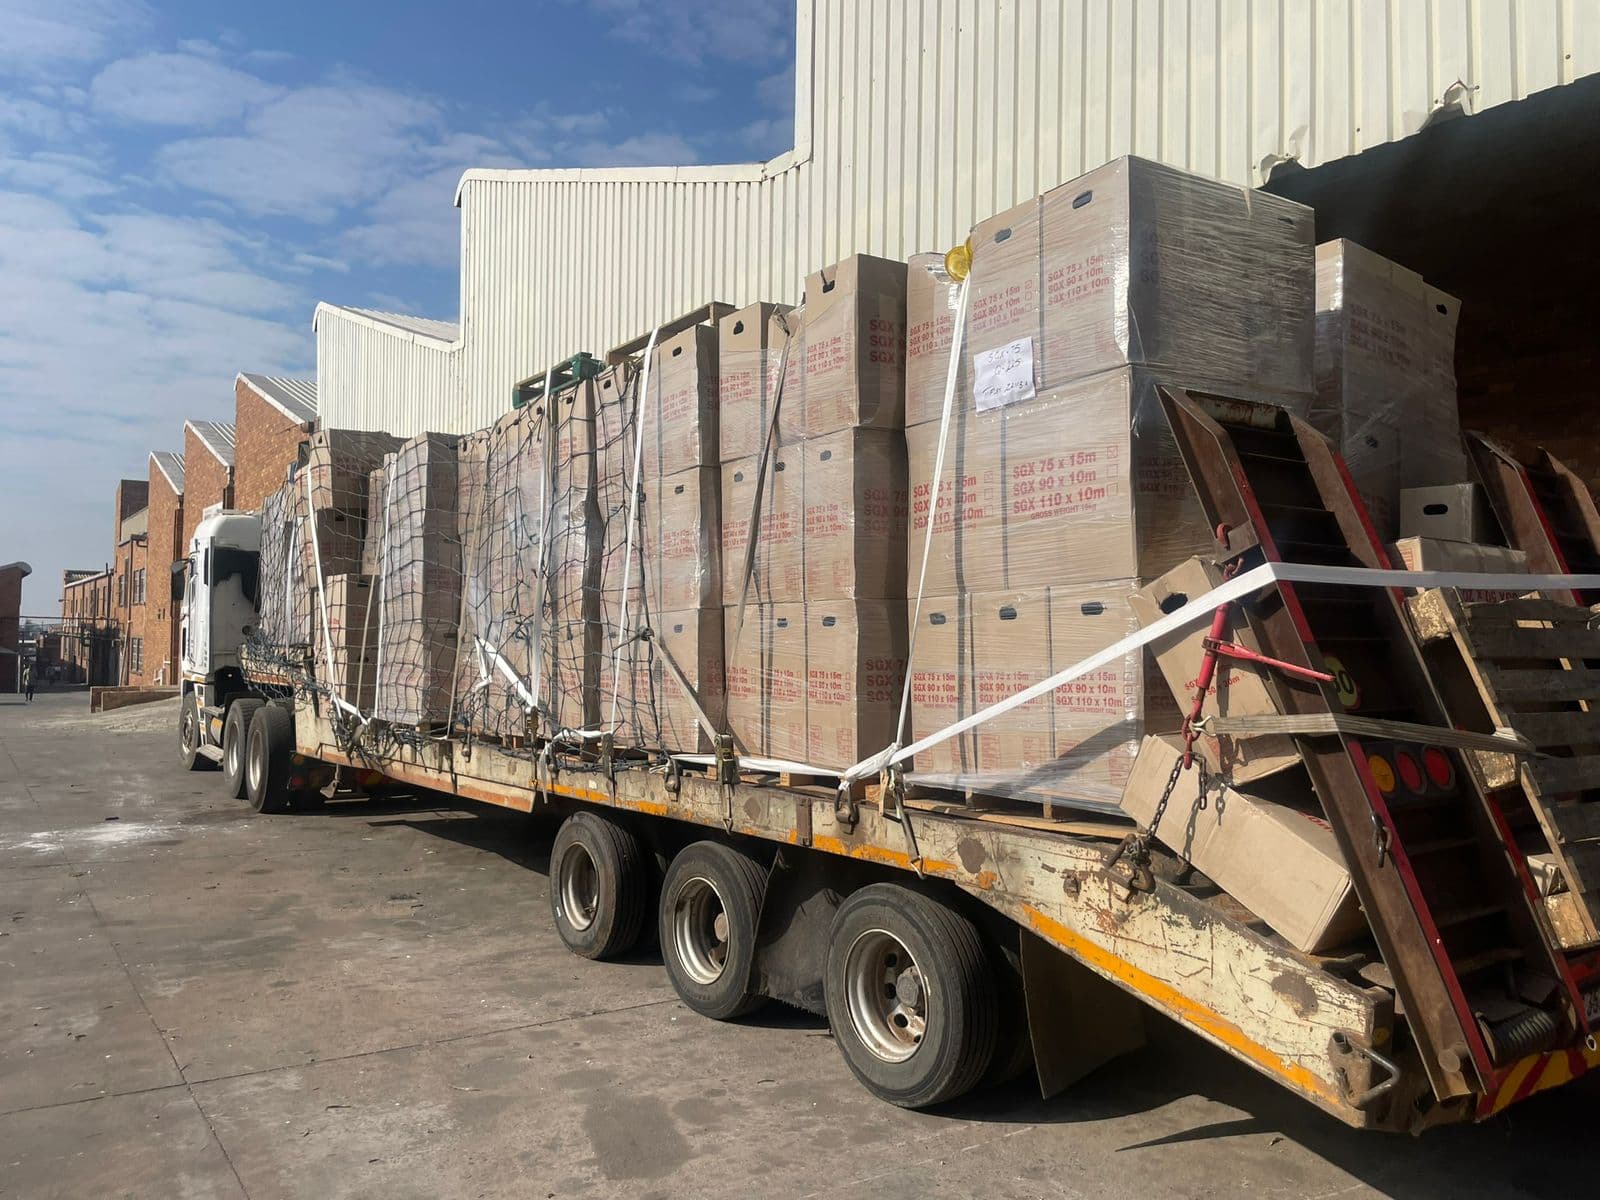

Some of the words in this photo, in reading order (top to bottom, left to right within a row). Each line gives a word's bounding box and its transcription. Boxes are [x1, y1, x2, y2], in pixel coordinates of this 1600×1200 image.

[1048, 269, 1064, 282] SGX
[1066, 264, 1076, 275] 75
[1086, 255, 1104, 266] 15m
[1048, 281, 1064, 294] SGX
[1085, 267, 1104, 278] 10m
[1048, 293, 1065, 306] SGX
[1067, 286, 1081, 298] 110
[1091, 277, 1110, 288] 10m
[974, 298, 988, 311] SGX
[1005, 286, 1020, 297] 15m
[973, 309, 988, 321] SGX
[989, 305, 997, 315] 90
[1005, 297, 1020, 308] 10m
[871, 319, 894, 331] SGX
[910, 325, 920, 336] SGX
[923, 321, 929, 330] 75
[936, 315, 950, 325] 15m
[871, 335, 895, 347] SGX
[910, 336, 920, 346] SGX
[921, 332, 929, 341] 90
[936, 326, 951, 336] 10m
[871, 351, 895, 363] SGX
[909, 346, 920, 357] SGX
[1013, 462, 1035, 479] SGX
[1040, 458, 1054, 472] 75
[1058, 459, 1064, 469] x
[1070, 452, 1096, 466] 15m
[1013, 480, 1035, 496] SGX
[1040, 476, 1054, 490] 90
[1058, 476, 1064, 486] x
[1069, 470, 1096, 484] 10m
[913, 484, 929, 498] SGX
[946, 481, 952, 491] x
[913, 500, 929, 513] SGX
[946, 498, 952, 506] x
[1013, 498, 1035, 513] SGX
[1040, 492, 1061, 508] 110
[1066, 494, 1072, 503] x
[1078, 486, 1105, 502] 10m
[913, 516, 929, 529] SGX
[963, 507, 984, 520] 10m
[1031, 509, 1052, 520] GROSS
[1054, 505, 1078, 515] WEIGHT
[866, 659, 893, 671] SGX
[866, 675, 893, 687] SGX
[913, 672, 926, 681] SGX
[942, 673, 955, 681] 15m
[980, 672, 993, 680] SGX
[996, 672, 1005, 680] 75
[1013, 671, 1029, 680] 15m
[1090, 673, 1094, 681] x
[1098, 672, 1116, 681] 15m
[830, 681, 841, 689] 10m
[913, 683, 926, 691] SGX
[927, 683, 935, 691] 90
[942, 683, 955, 692] 10m
[979, 683, 993, 691] SGX
[996, 683, 1005, 691] 90
[1056, 684, 1073, 693] SGX
[1076, 684, 1086, 693] 90
[1089, 686, 1094, 694] x
[1098, 684, 1116, 693] 10m
[867, 690, 893, 702] SGX
[913, 694, 926, 702] SGX
[928, 694, 939, 703] 110
[946, 695, 960, 703] 10m
[979, 694, 993, 703] SGX
[1056, 696, 1073, 706] SGX
[1076, 696, 1092, 706] 110
[1095, 698, 1100, 707] x
[1103, 697, 1122, 707] 10m
